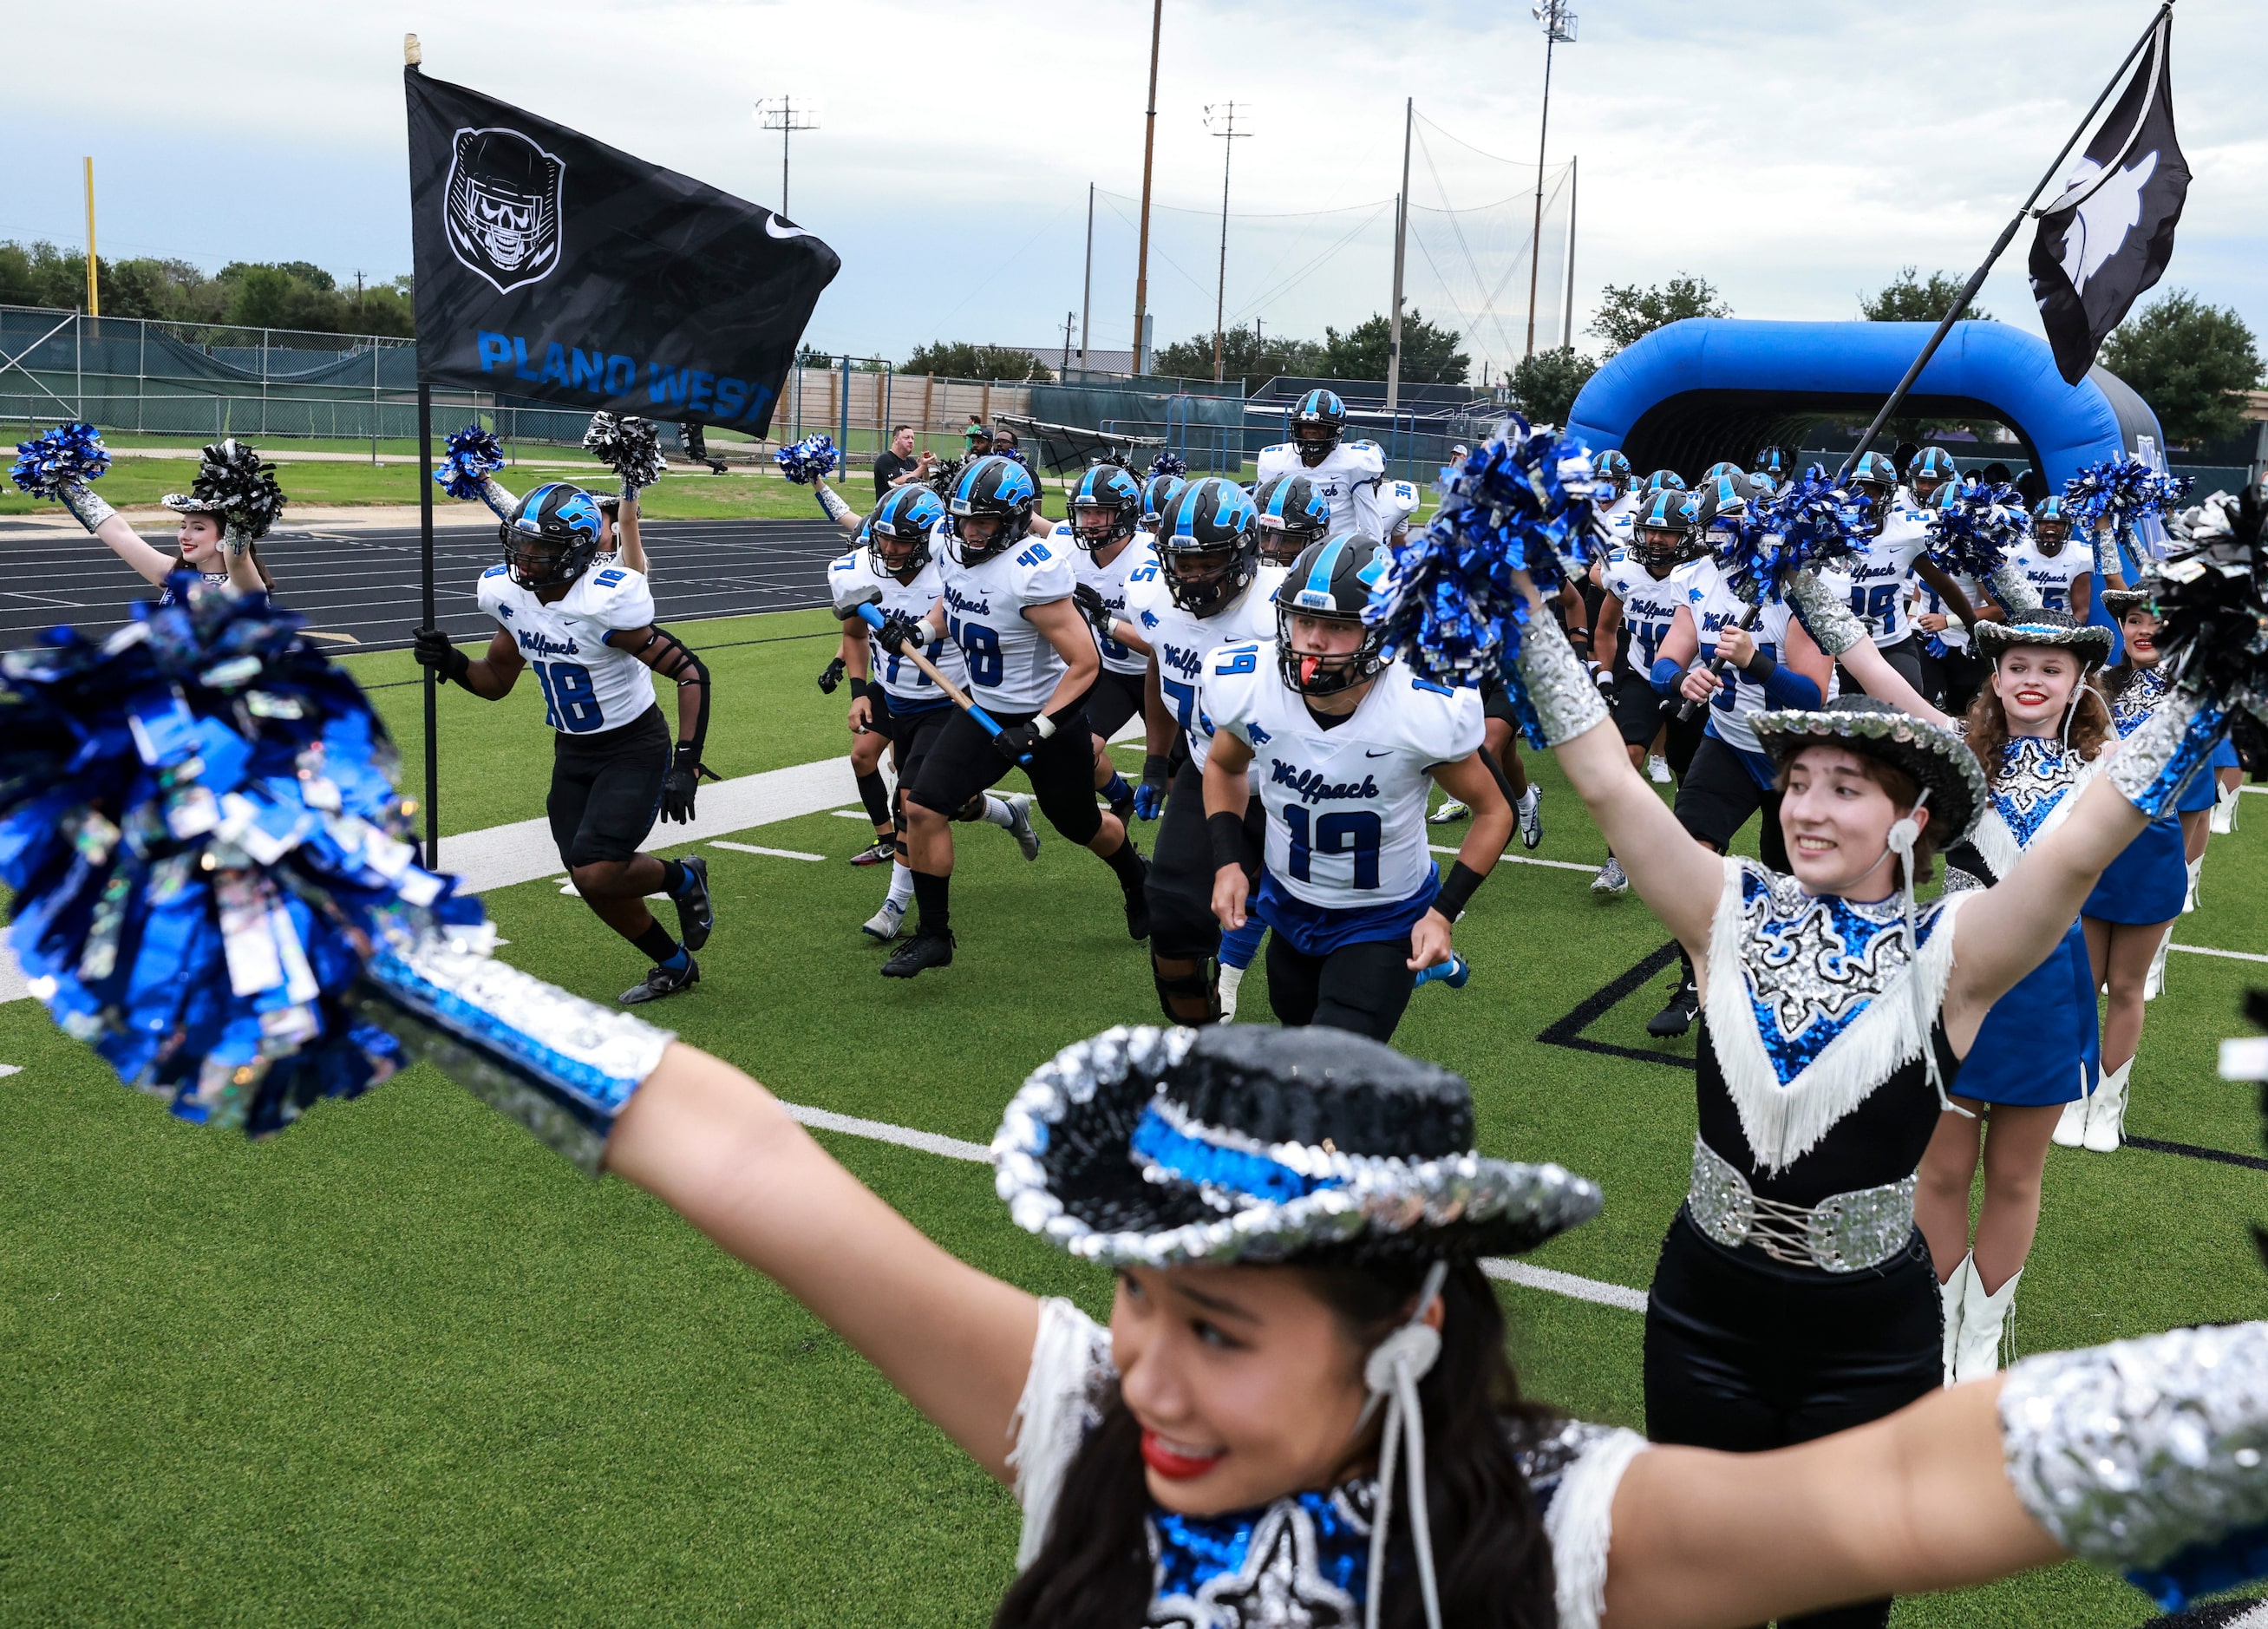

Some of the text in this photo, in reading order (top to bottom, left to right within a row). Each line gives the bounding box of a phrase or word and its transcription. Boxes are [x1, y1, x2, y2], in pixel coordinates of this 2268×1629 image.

[478, 330, 774, 422] PLANO WEST
[1395, 482, 1412, 500] 36
[1016, 543, 1052, 567] 48
[593, 568, 628, 589] 18
[1631, 597, 1676, 620] Wolfpac
[518, 629, 579, 657] Wolfpack
[1216, 644, 1258, 676] 19
[533, 660, 605, 733] 18
[1411, 678, 1454, 698] 1
[1271, 758, 1380, 805] Wolfpack
[1283, 803, 1382, 890] 19
